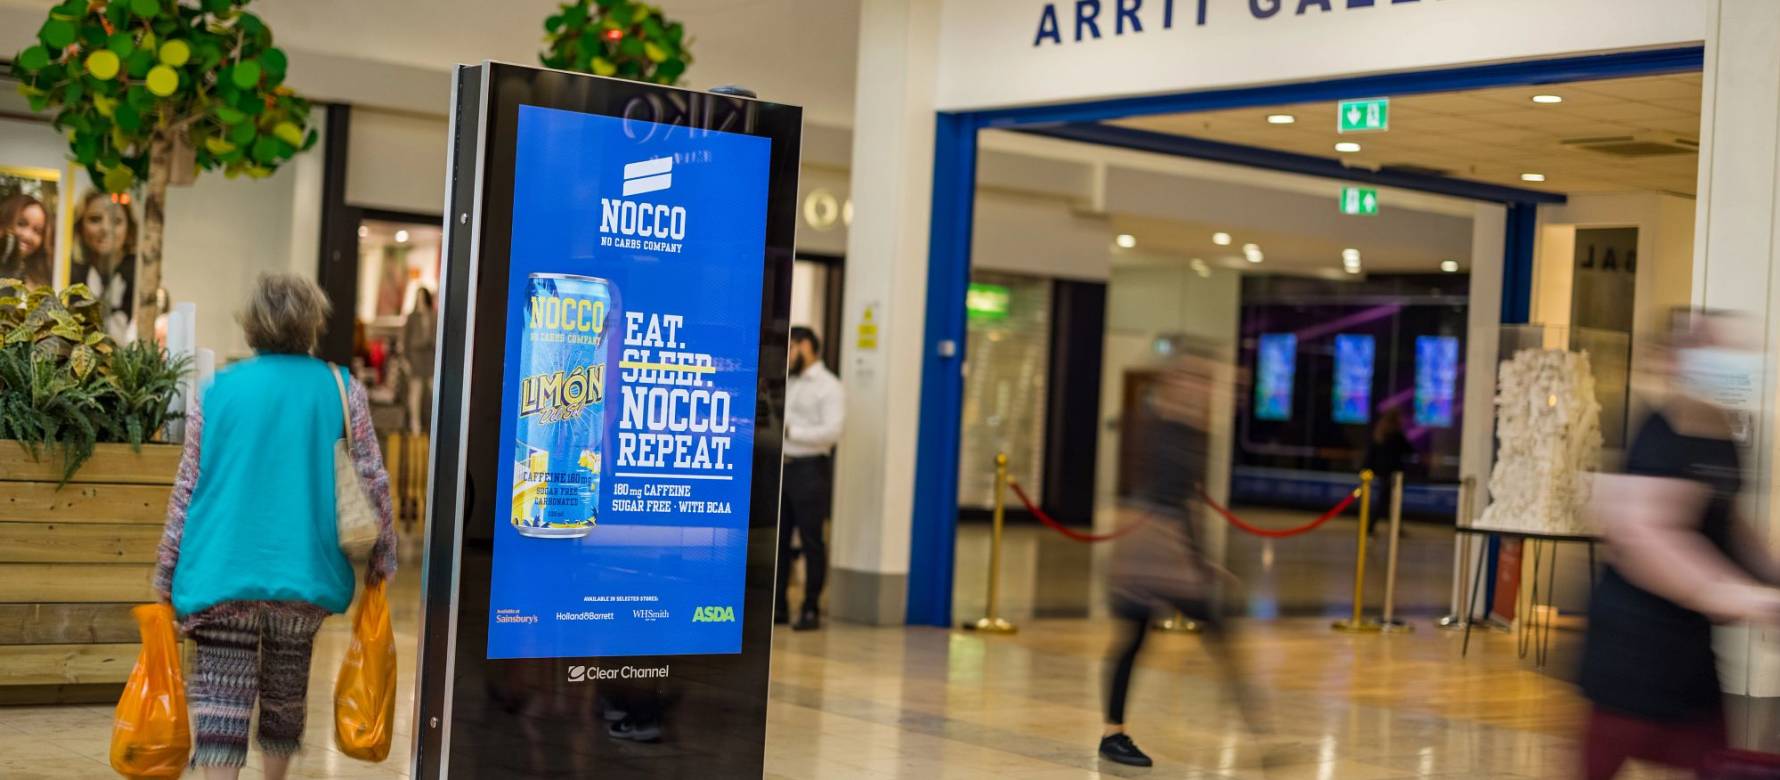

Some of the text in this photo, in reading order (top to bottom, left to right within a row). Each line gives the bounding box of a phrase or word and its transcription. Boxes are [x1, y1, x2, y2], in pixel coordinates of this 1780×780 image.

[1034, 0, 1208, 47] ARR
[600, 198, 686, 241] NOCCO
[601, 236, 682, 253] NO CARBS COMPANY
[530, 296, 604, 334] NOCCO
[624, 311, 684, 348] EAT.
[567, 334, 601, 346] COMPANY
[621, 348, 714, 387] SLEEP.
[521, 364, 605, 416] LIMÓN
[620, 385, 735, 433] NOCCO.
[617, 432, 733, 469] REPEAT.
[523, 472, 566, 483] CAFFEINE
[644, 484, 691, 497] CAFFEINE
[535, 497, 578, 506] CARBONATED
[612, 499, 732, 514] SUGAR FREE WITH BCAA
[496, 614, 538, 624] Sainsbury's
[632, 609, 670, 618] WHSmith
[692, 606, 735, 622] ASDA
[587, 665, 669, 680] Clear Channel
